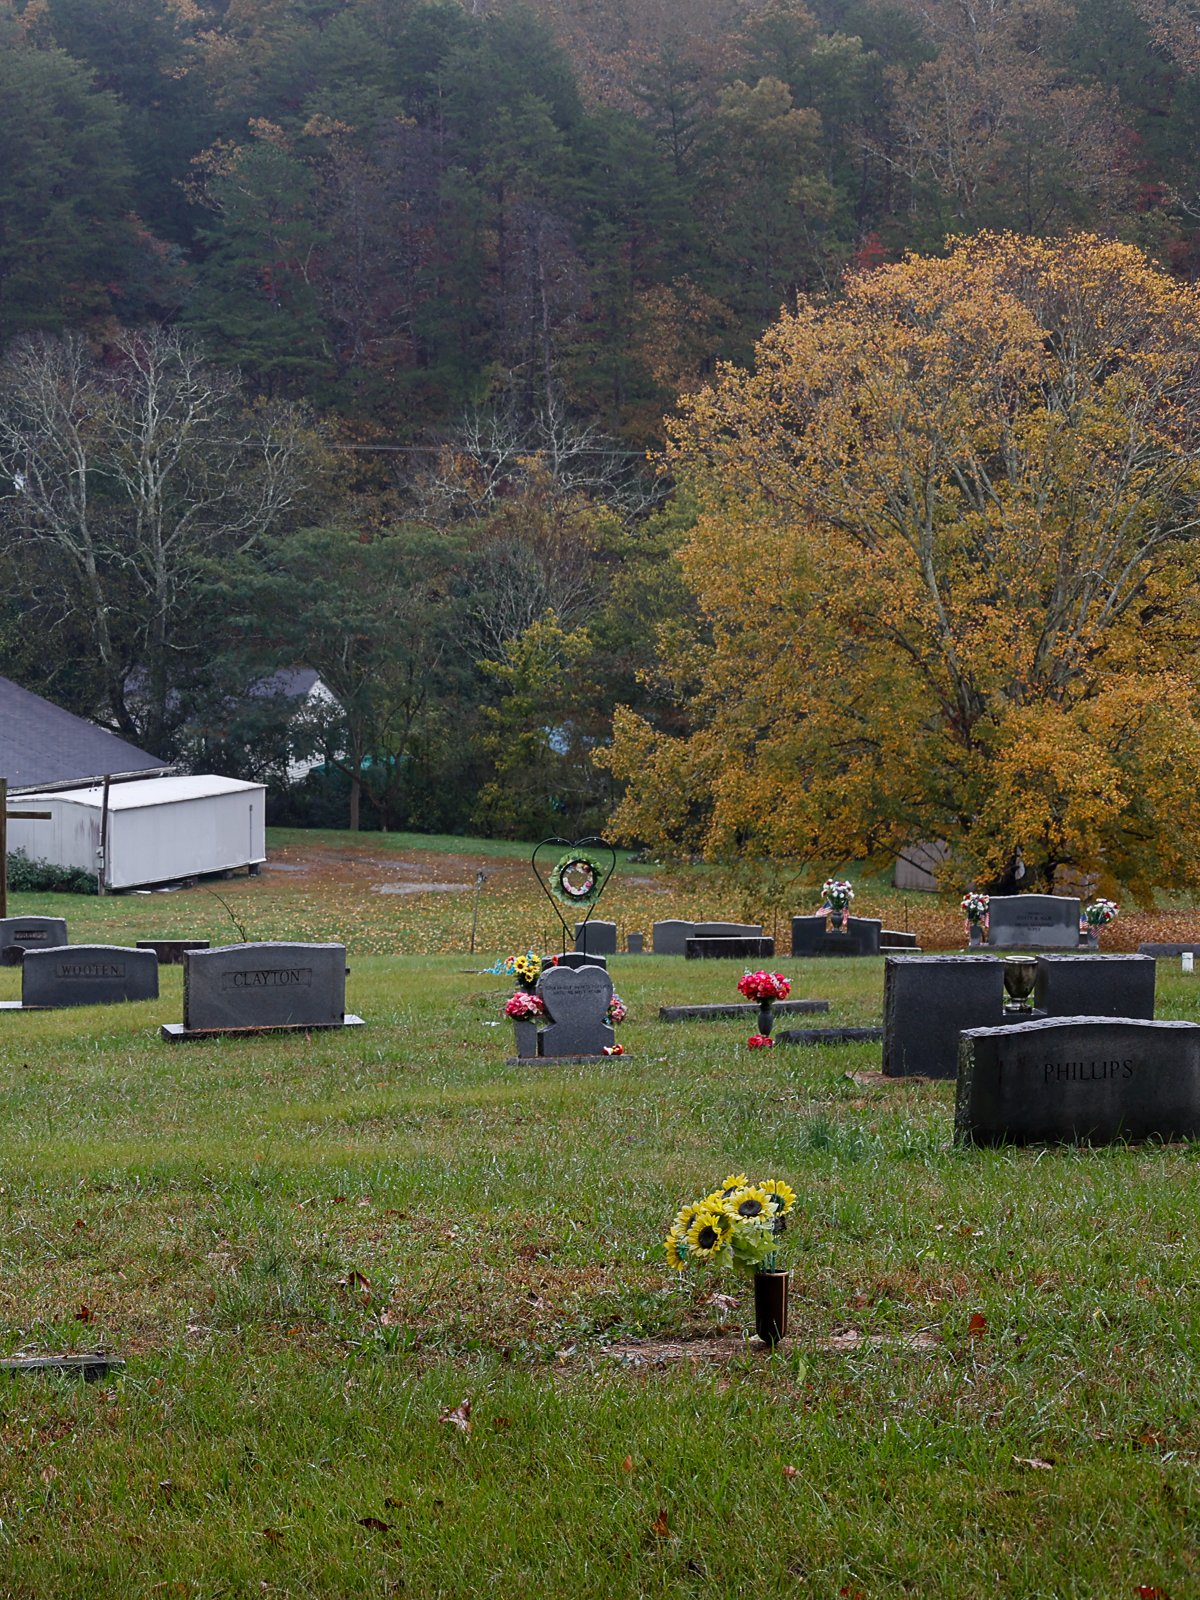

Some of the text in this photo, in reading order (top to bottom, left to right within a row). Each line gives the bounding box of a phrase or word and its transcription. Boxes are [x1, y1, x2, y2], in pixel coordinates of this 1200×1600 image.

[61, 965, 120, 977] WOOTEN
[233, 971, 300, 987] CLAYTON
[1044, 1059, 1134, 1083] PHILLIPS
